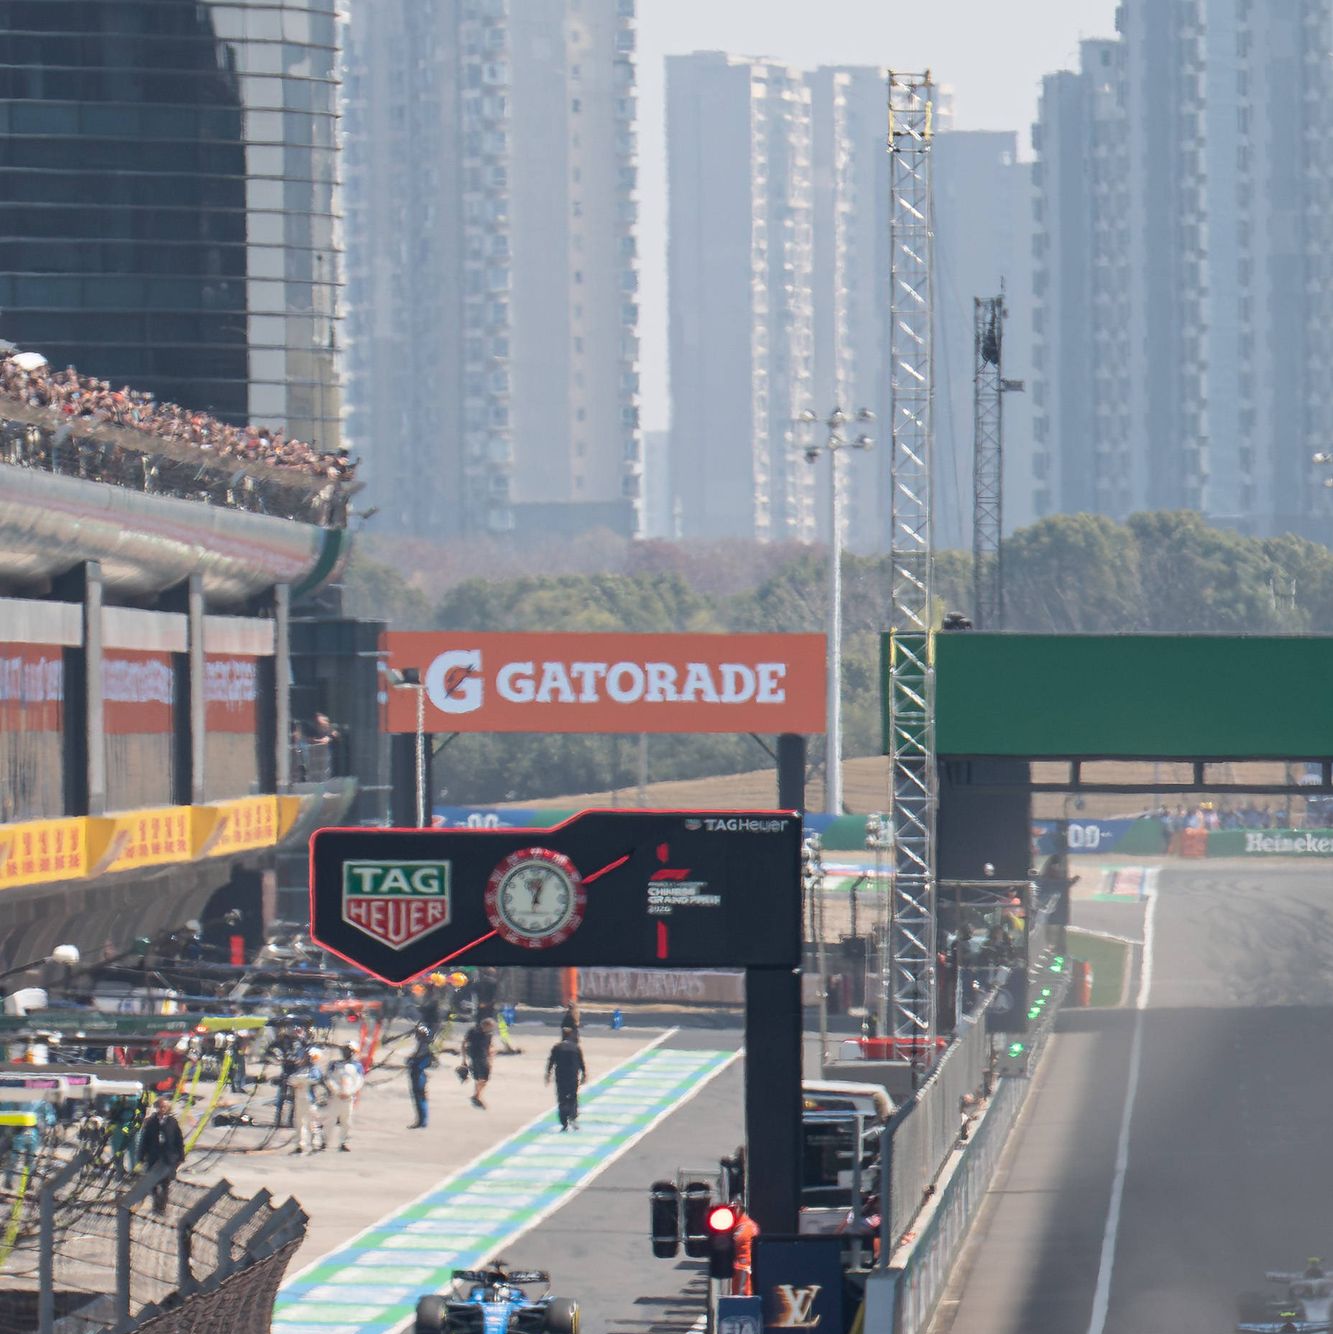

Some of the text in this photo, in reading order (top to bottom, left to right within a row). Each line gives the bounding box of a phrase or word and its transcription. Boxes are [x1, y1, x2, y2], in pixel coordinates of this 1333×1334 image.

[496, 661, 787, 704] GATORADE
[351, 867, 440, 895] TAG
[349, 902, 444, 941] HEUER
